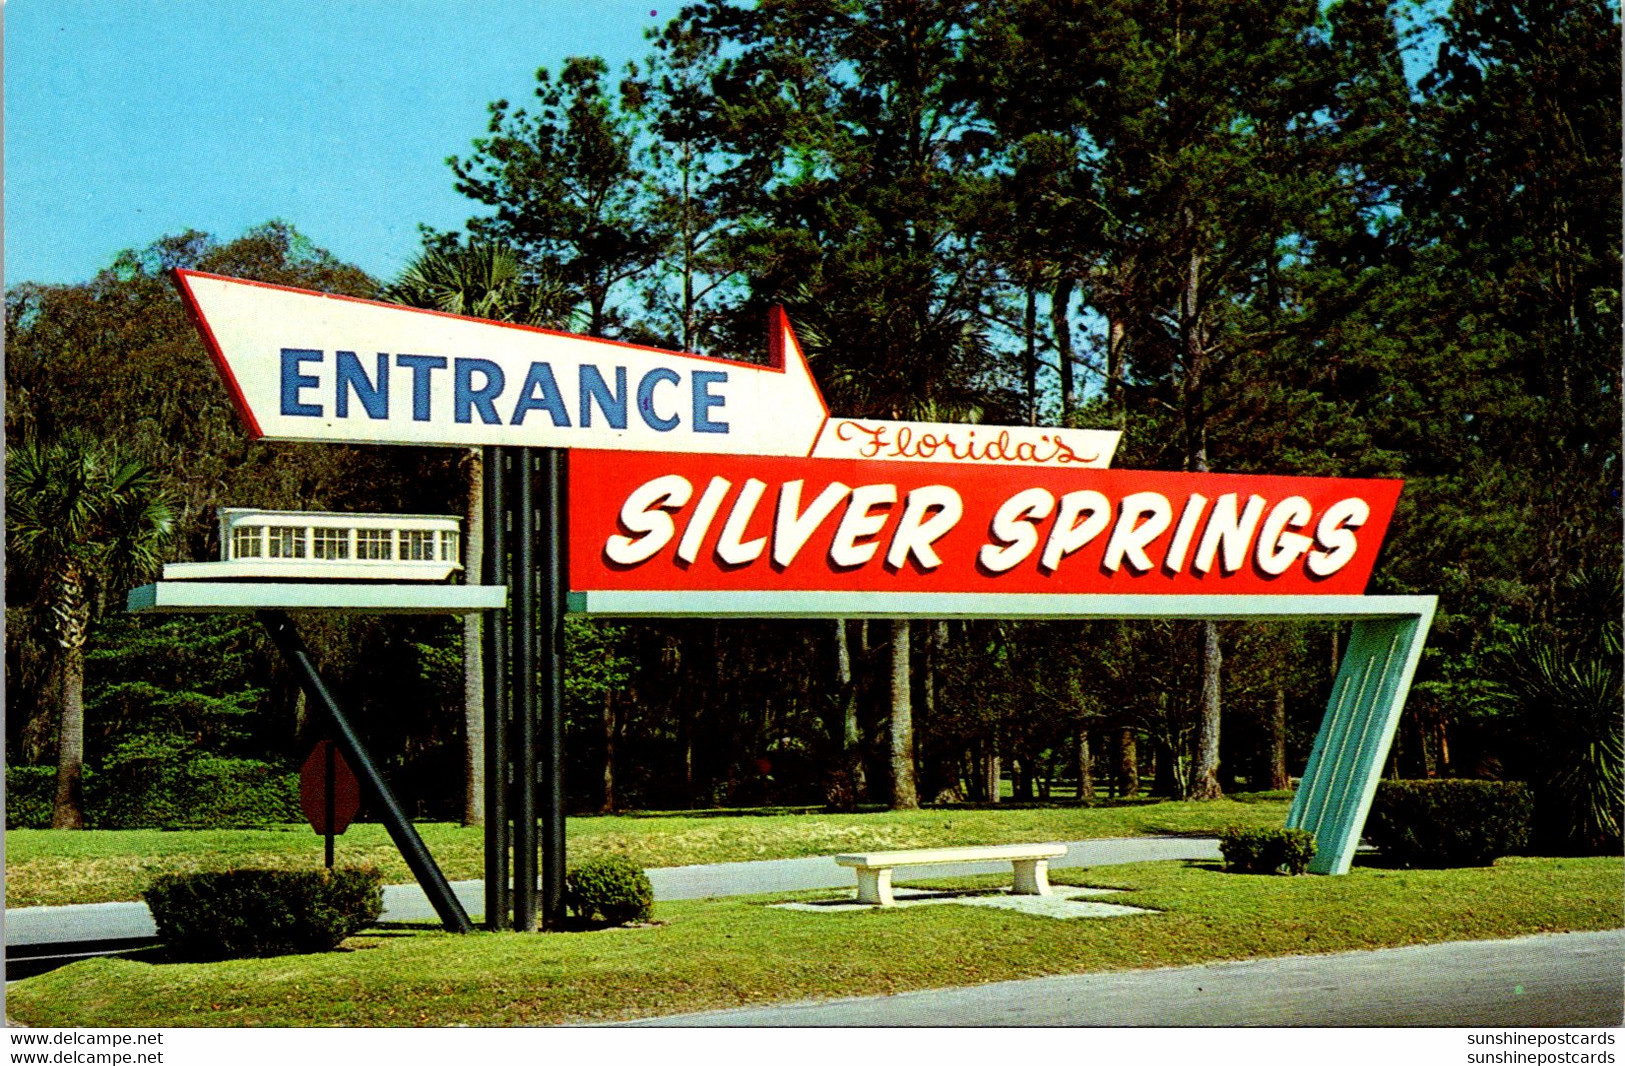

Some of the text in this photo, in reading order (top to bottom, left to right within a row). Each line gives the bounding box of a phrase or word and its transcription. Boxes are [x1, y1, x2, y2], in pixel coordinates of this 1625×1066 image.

[280, 347, 729, 434] ENTRANCE
[837, 420, 1099, 463] Florida's
[604, 474, 1370, 577] SILVER SPRINGS
